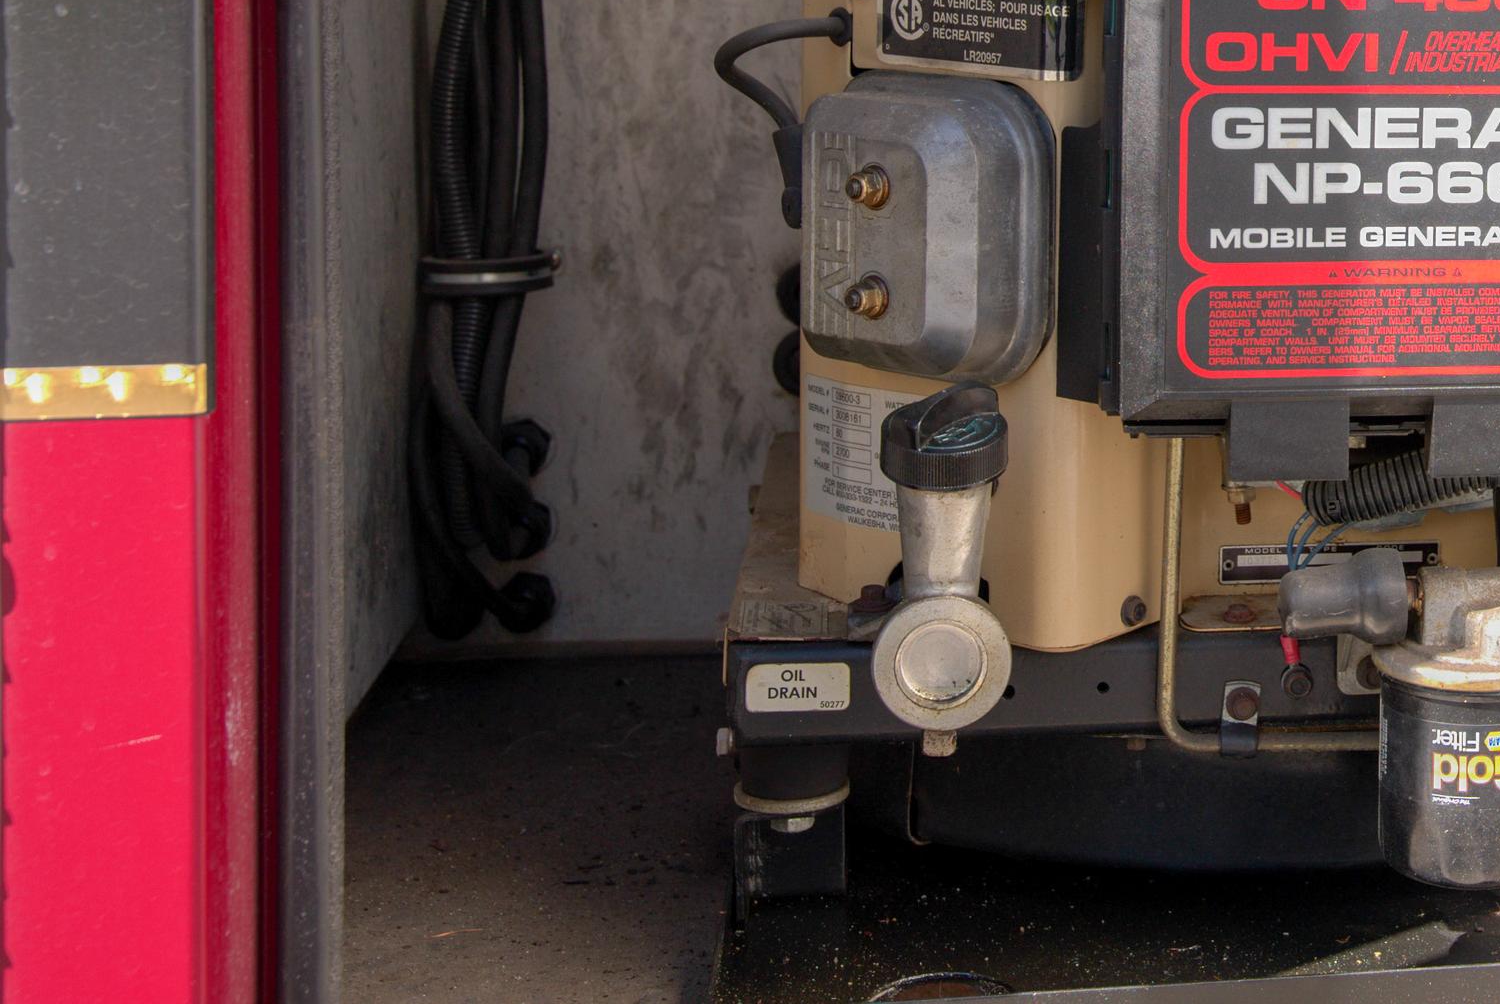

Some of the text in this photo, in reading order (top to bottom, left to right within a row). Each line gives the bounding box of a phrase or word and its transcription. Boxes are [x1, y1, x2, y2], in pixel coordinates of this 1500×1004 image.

[1000, 2, 1028, 14] POUR
[1029, 4, 1070, 17] USAGE
[933, 11, 1028, 31] DANS LES VEHICLES
[963, 51, 1002, 64] LR20957
[1205, 32, 1379, 72] OHVI
[1209, 227, 1347, 249] MOBILE
[1343, 267, 1447, 277] WARNING
[1209, 290, 1228, 299] FOR
[1232, 290, 1252, 299] FIRE
[1297, 289, 1317, 298] THIS
[1321, 289, 1376, 298] GENERATOR
[1380, 288, 1406, 297] MUST
[1410, 288, 1422, 297] BE
[1426, 288, 1475, 296] INSTALLED
[1209, 300, 1262, 309] FORMANCE
[1268, 299, 1292, 308] WITH
[1389, 298, 1432, 307] DETAILED
[1209, 309, 1258, 318] ADEQUATE
[1261, 309, 1319, 317] VENTILATION
[1322, 308, 1333, 317] OF
[1337, 307, 1409, 316] COMPARTMENT
[1411, 307, 1438, 315] MUST
[1441, 307, 1452, 315] BE
[1455, 306, 1500, 315] PROVIDED
[1209, 319, 1251, 327] OWNERS
[1312, 317, 1383, 326] COMPARTMENT
[1389, 316, 1415, 325] MUST
[1438, 315, 1470, 324] VAPOR
[1209, 328, 1239, 337] SPACE
[1243, 328, 1256, 337] OF
[1374, 326, 1419, 335] MINIMUM
[1423, 325, 1476, 334] CLEARANCE
[1209, 337, 1281, 346] COMPARTMENT
[1328, 336, 1350, 344] UNIT
[1353, 335, 1380, 344] MUST
[1400, 334, 1446, 343] MOUNTED
[1450, 334, 1496, 343] SECURELY
[1243, 346, 1272, 355] REFER
[1276, 346, 1287, 355] TO
[1290, 346, 1331, 355] OWNERS
[1334, 345, 1374, 354] MANUAL
[1377, 345, 1395, 353] FOR
[1399, 344, 1451, 353] ADDITIONAL
[1266, 356, 1286, 365] AND
[1289, 356, 1326, 364] SERVICE
[780, 669, 806, 682] OIL
[767, 686, 818, 699] DRAIN
[820, 700, 845, 708] 50277
